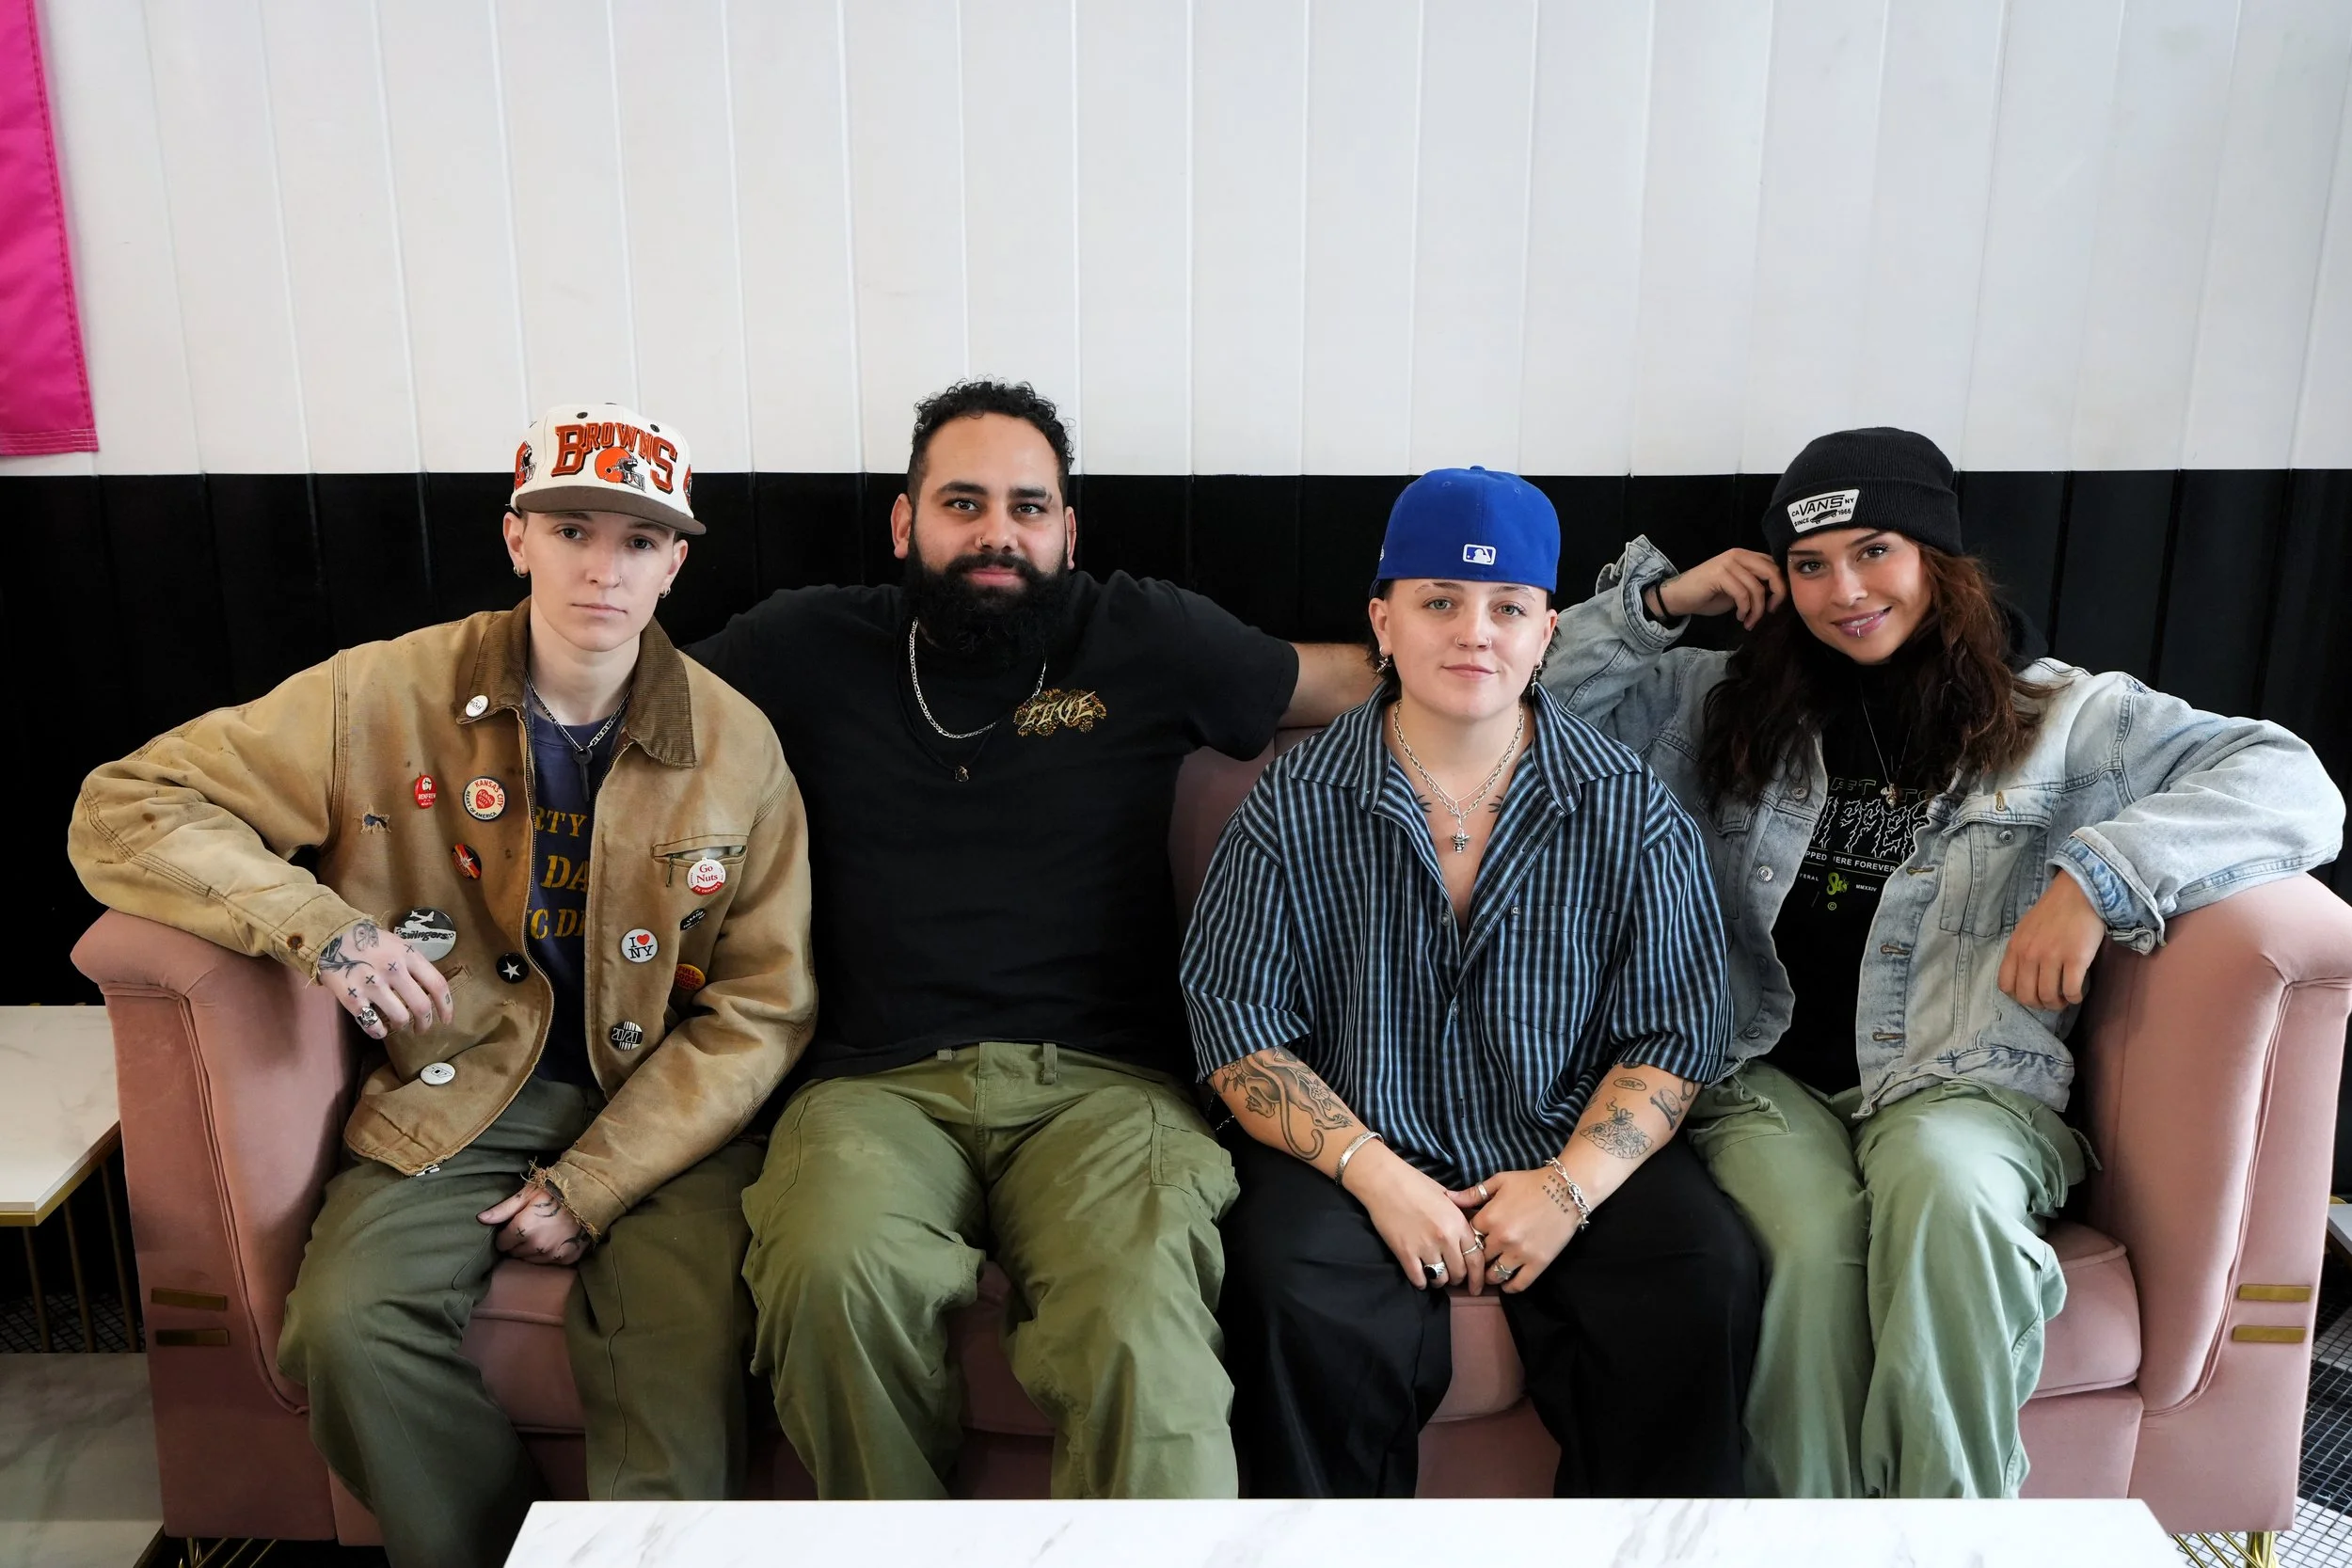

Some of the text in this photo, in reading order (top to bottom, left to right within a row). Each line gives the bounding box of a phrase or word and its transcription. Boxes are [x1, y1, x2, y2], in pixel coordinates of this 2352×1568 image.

[551, 422, 677, 494] BROWNS
[1799, 495, 1845, 516] VANS
[1794, 517, 1809, 527] SINCE
[474, 780, 504, 808] KANSAS CITY
[465, 790, 477, 807] HEART
[474, 811, 497, 819] AMERICA
[534, 806, 588, 837] RTY
[699, 863, 713, 873] Go
[1854, 860, 1897, 874] FOREVER
[696, 874, 719, 883] Nuts
[1855, 884, 1878, 893] MMXXIV
[629, 936, 637, 948] I
[628, 944, 654, 958] NY
[612, 1027, 639, 1044] 20/20
